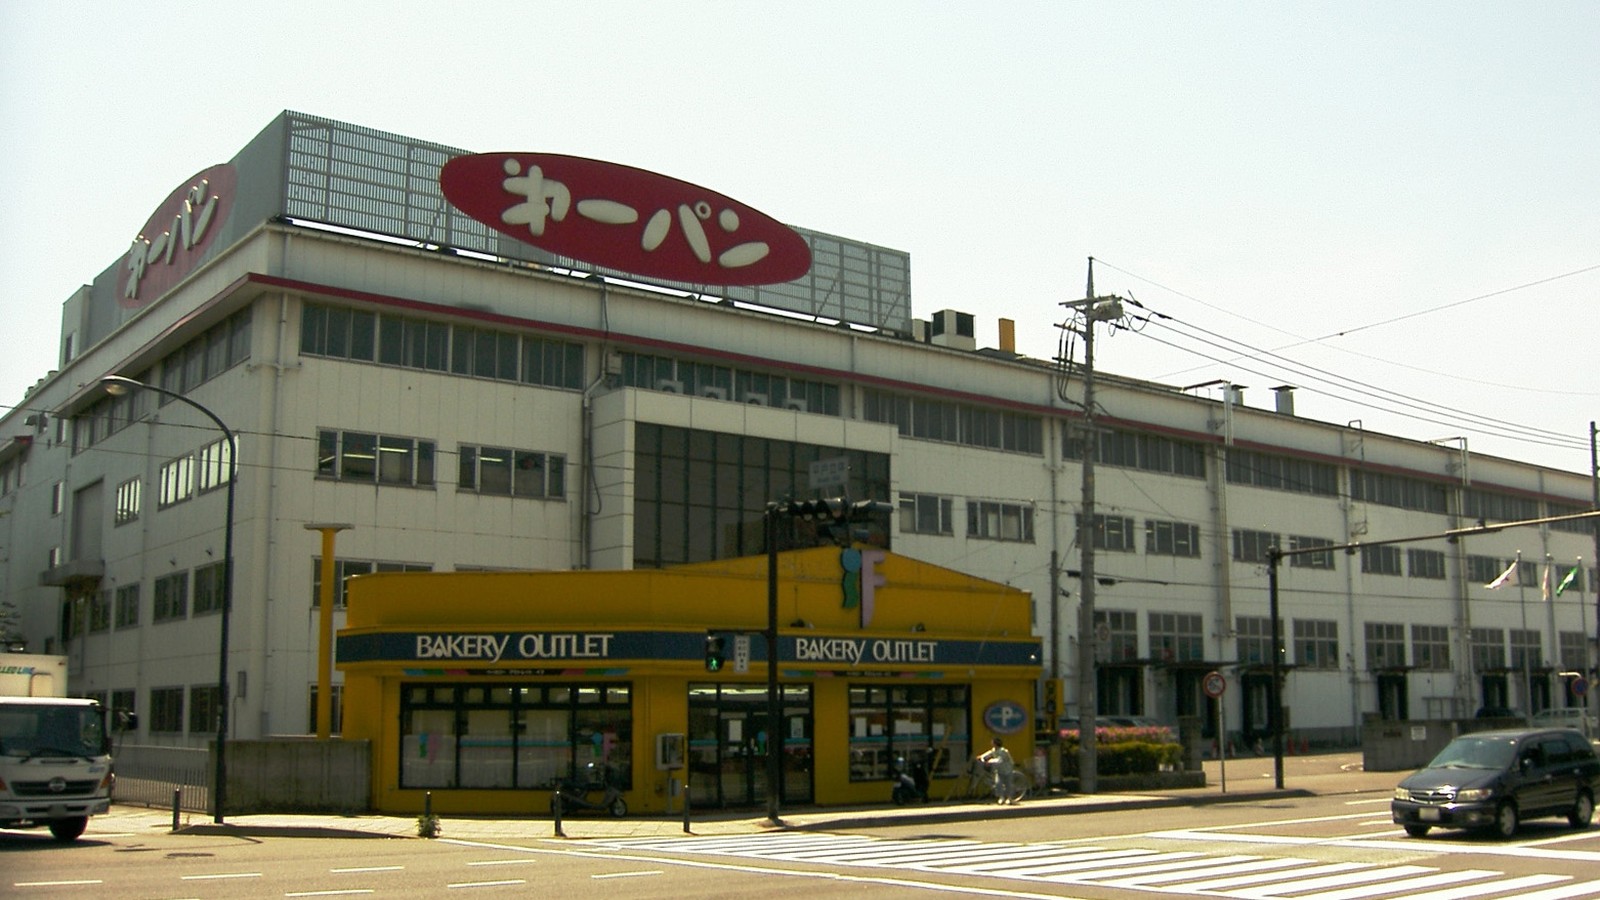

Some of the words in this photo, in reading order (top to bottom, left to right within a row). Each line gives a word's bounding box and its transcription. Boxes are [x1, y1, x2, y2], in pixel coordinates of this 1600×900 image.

[416, 634, 510, 663] BAKERY
[518, 634, 614, 658] OUTLET
[796, 638, 866, 665] BAKERY
[872, 640, 938, 662] OUTLET
[1001, 706, 1014, 726] P
